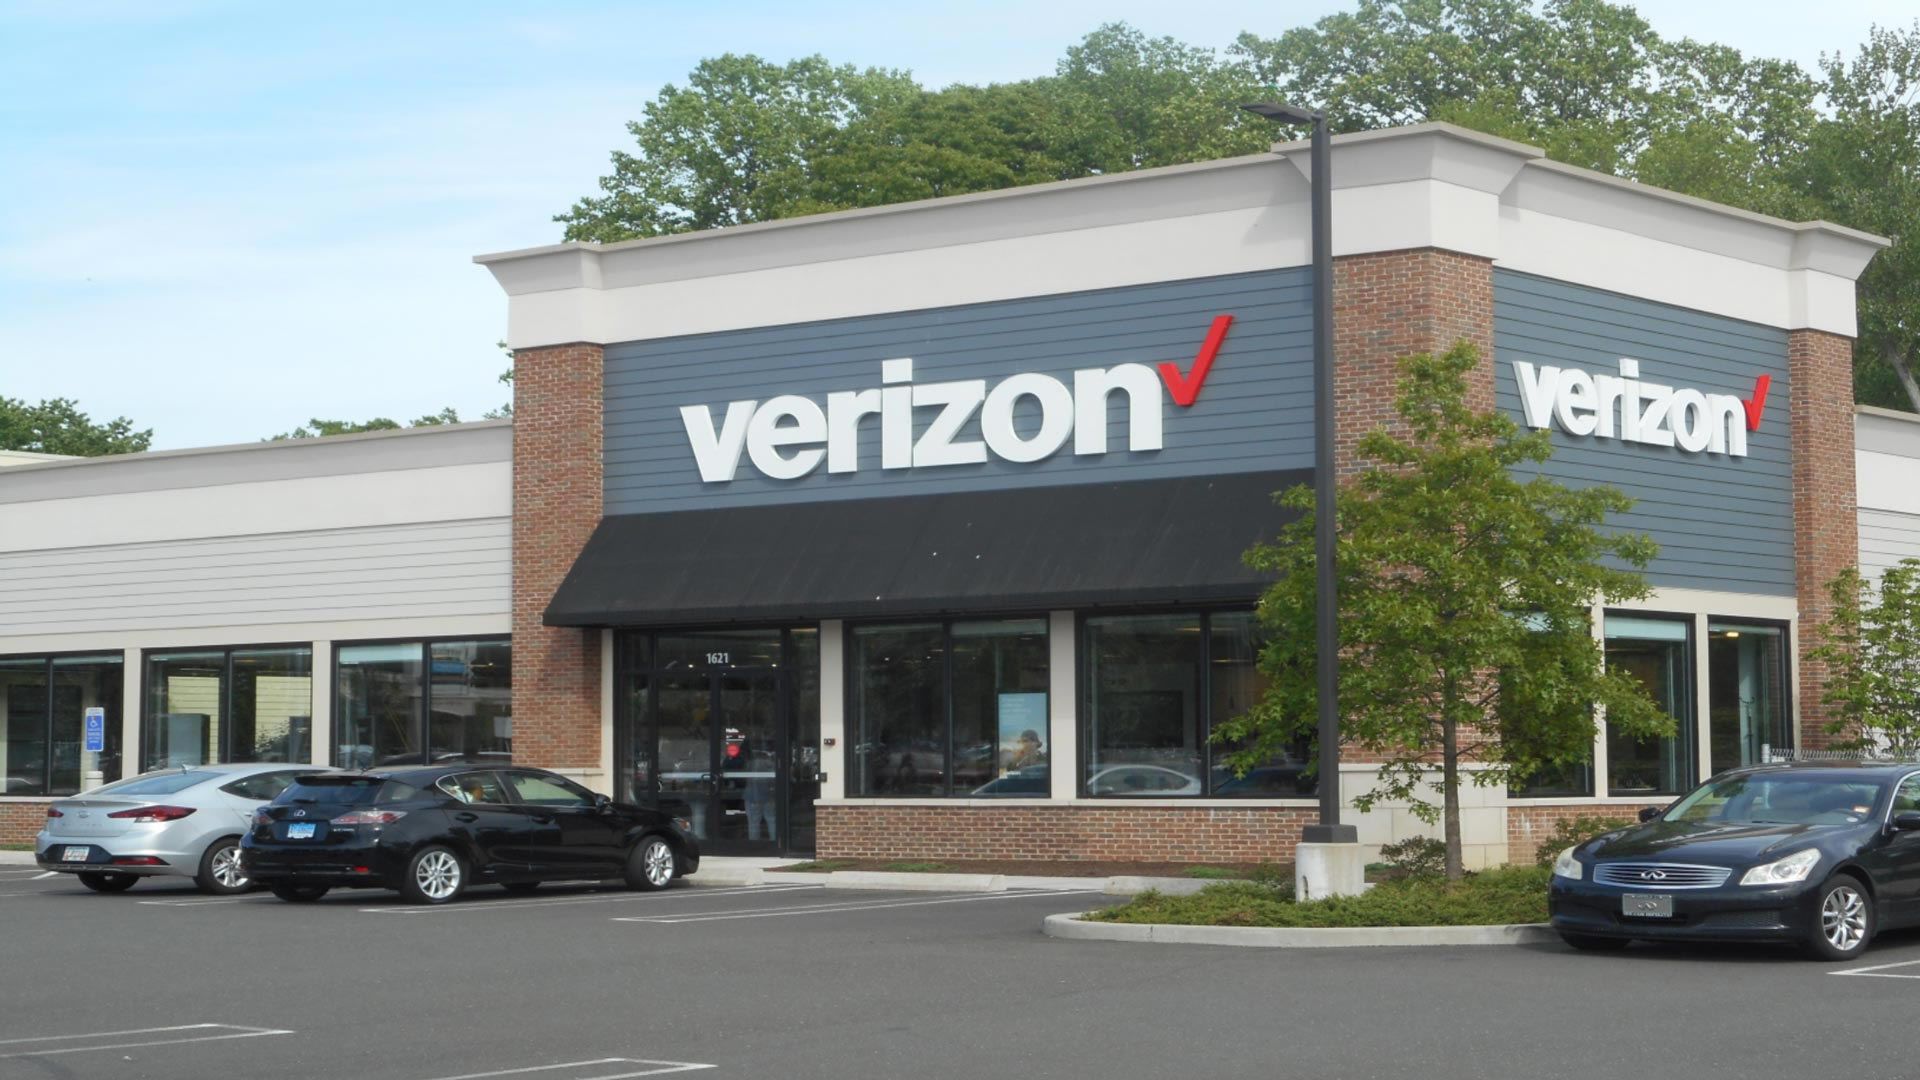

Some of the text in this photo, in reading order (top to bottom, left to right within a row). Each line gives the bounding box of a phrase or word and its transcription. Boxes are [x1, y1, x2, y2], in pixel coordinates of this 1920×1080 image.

[680, 358, 1163, 482] verizon
[1512, 358, 1747, 457] verizon
[706, 652, 729, 664] 1621
